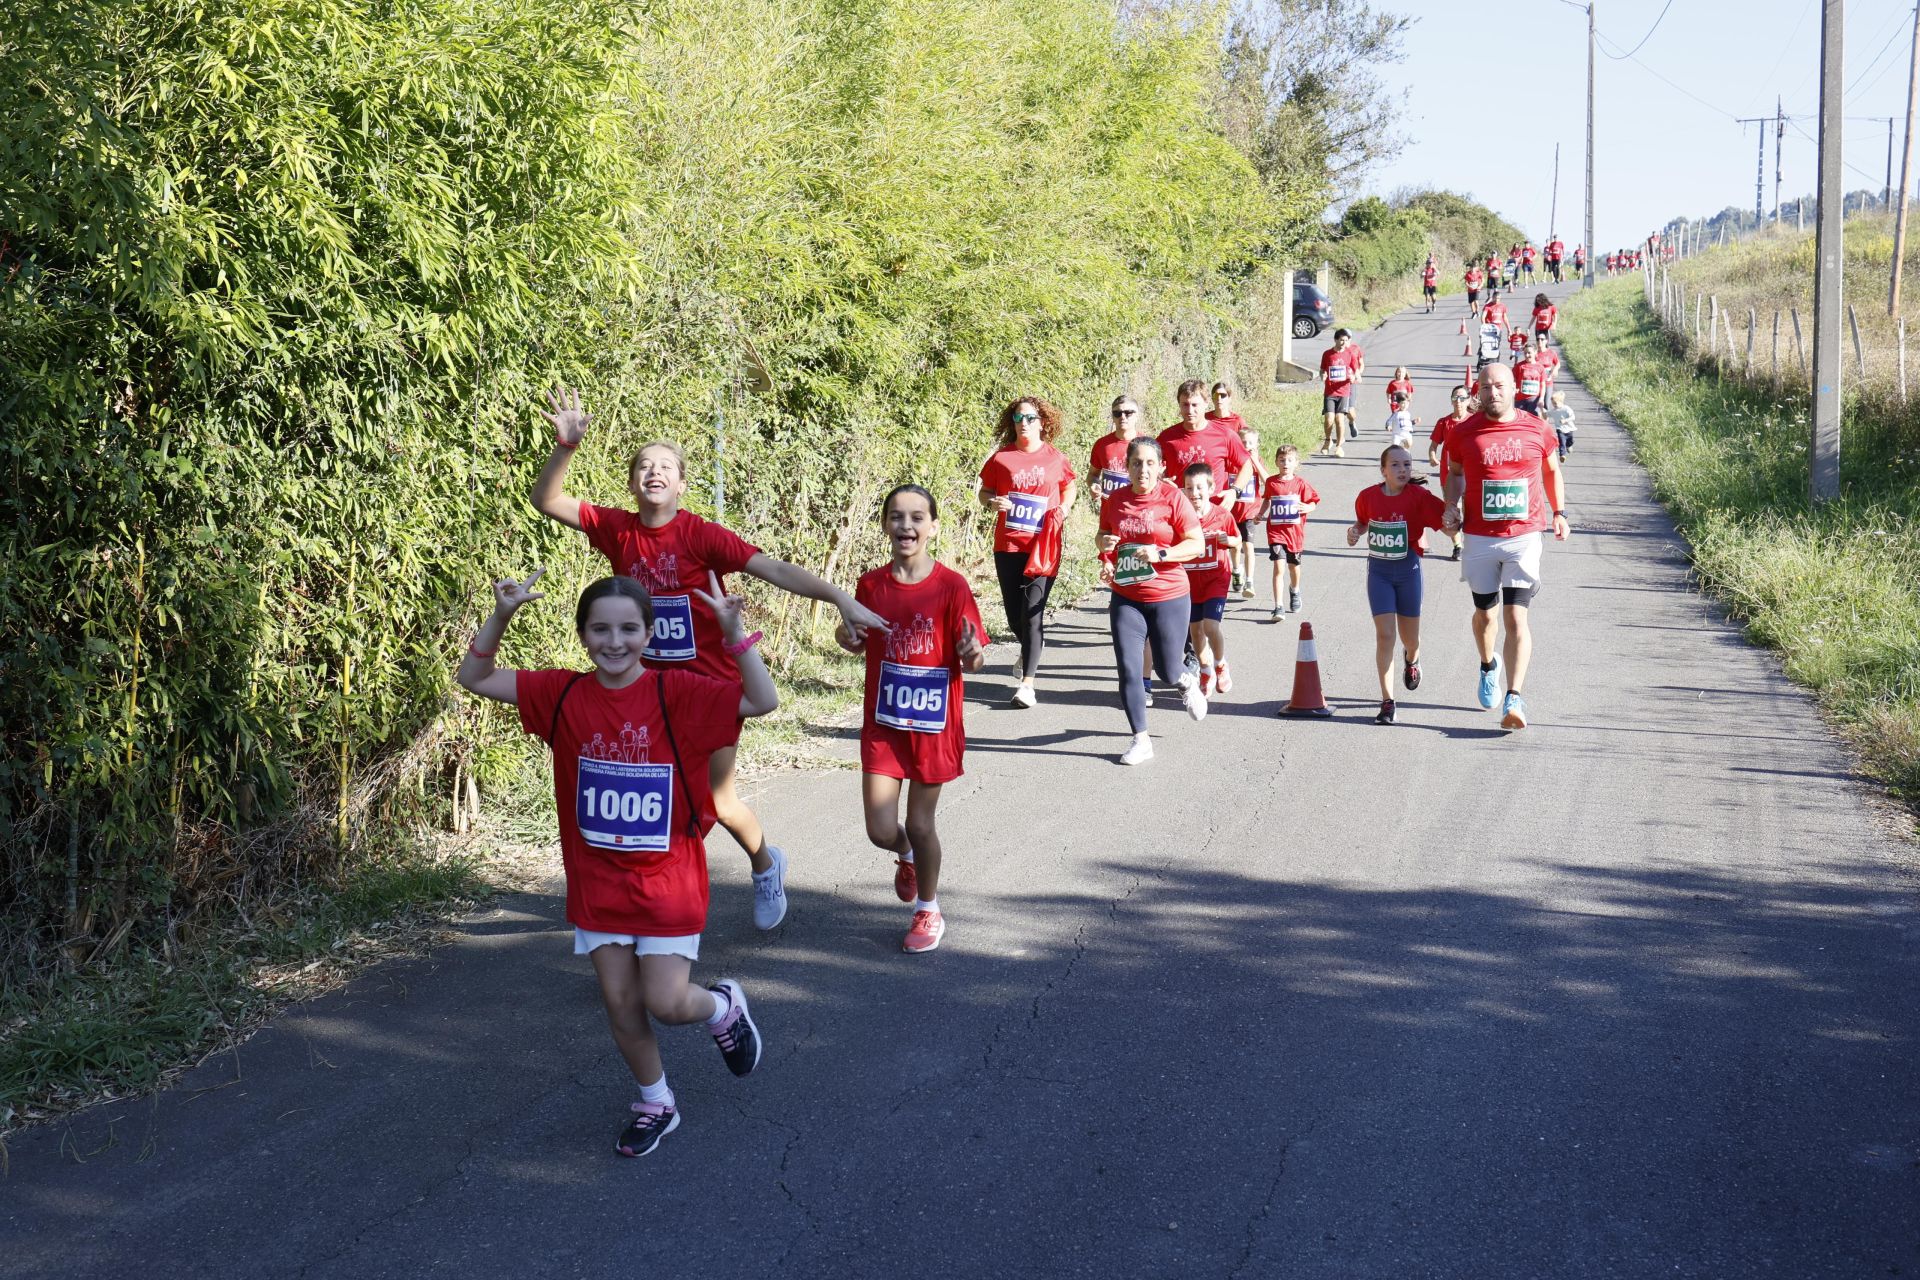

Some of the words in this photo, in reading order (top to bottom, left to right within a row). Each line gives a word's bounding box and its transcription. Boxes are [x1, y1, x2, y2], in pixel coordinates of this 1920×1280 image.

[1485, 493, 1525, 508] 2064
[1369, 532, 1404, 548] 2064
[654, 617, 686, 640] 05
[883, 683, 943, 712] 1005
[583, 786, 663, 823] 1006
